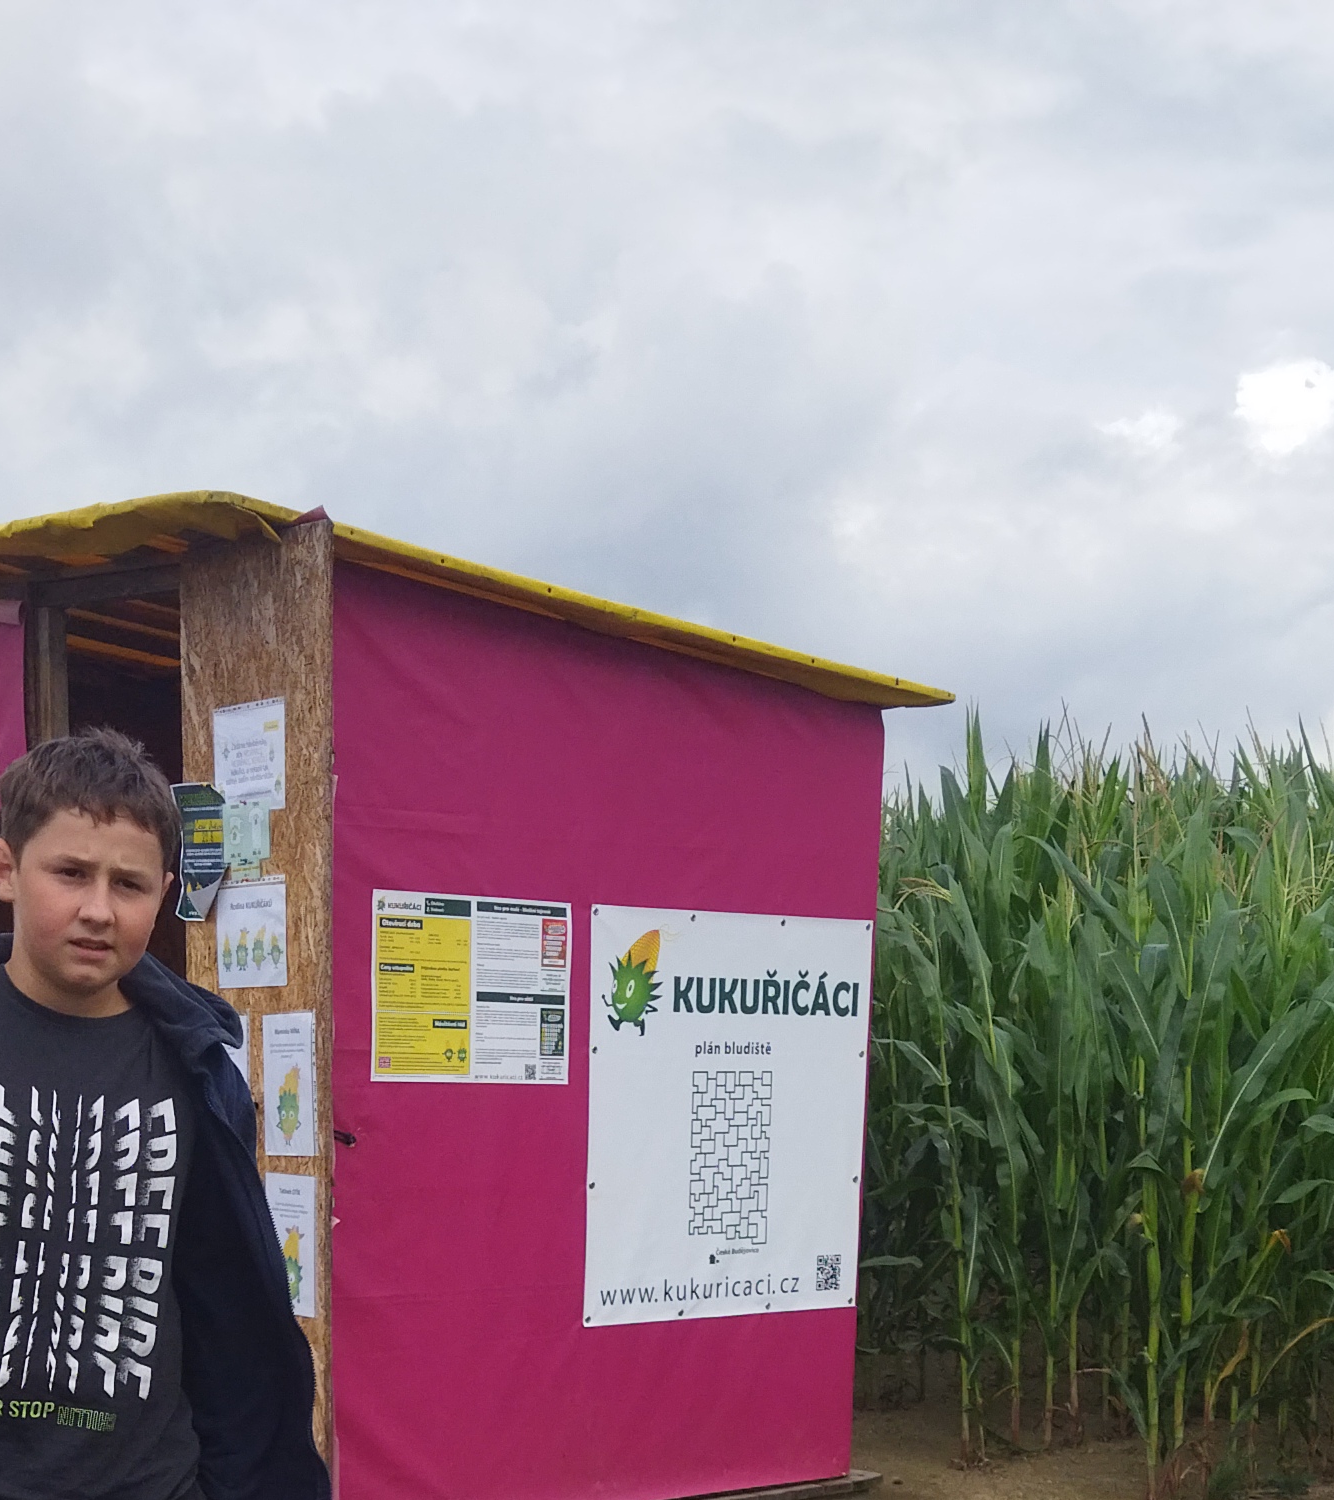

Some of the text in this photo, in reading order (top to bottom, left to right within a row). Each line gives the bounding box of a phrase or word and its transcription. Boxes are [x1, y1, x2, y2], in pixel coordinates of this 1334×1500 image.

[673, 969, 859, 1017] KUKUŘIČÁCI
[695, 1041, 772, 1057] plán bludiště
[600, 1274, 799, 1306] www.kukuricaci.cz
[9, 1400, 55, 1419] STOP
